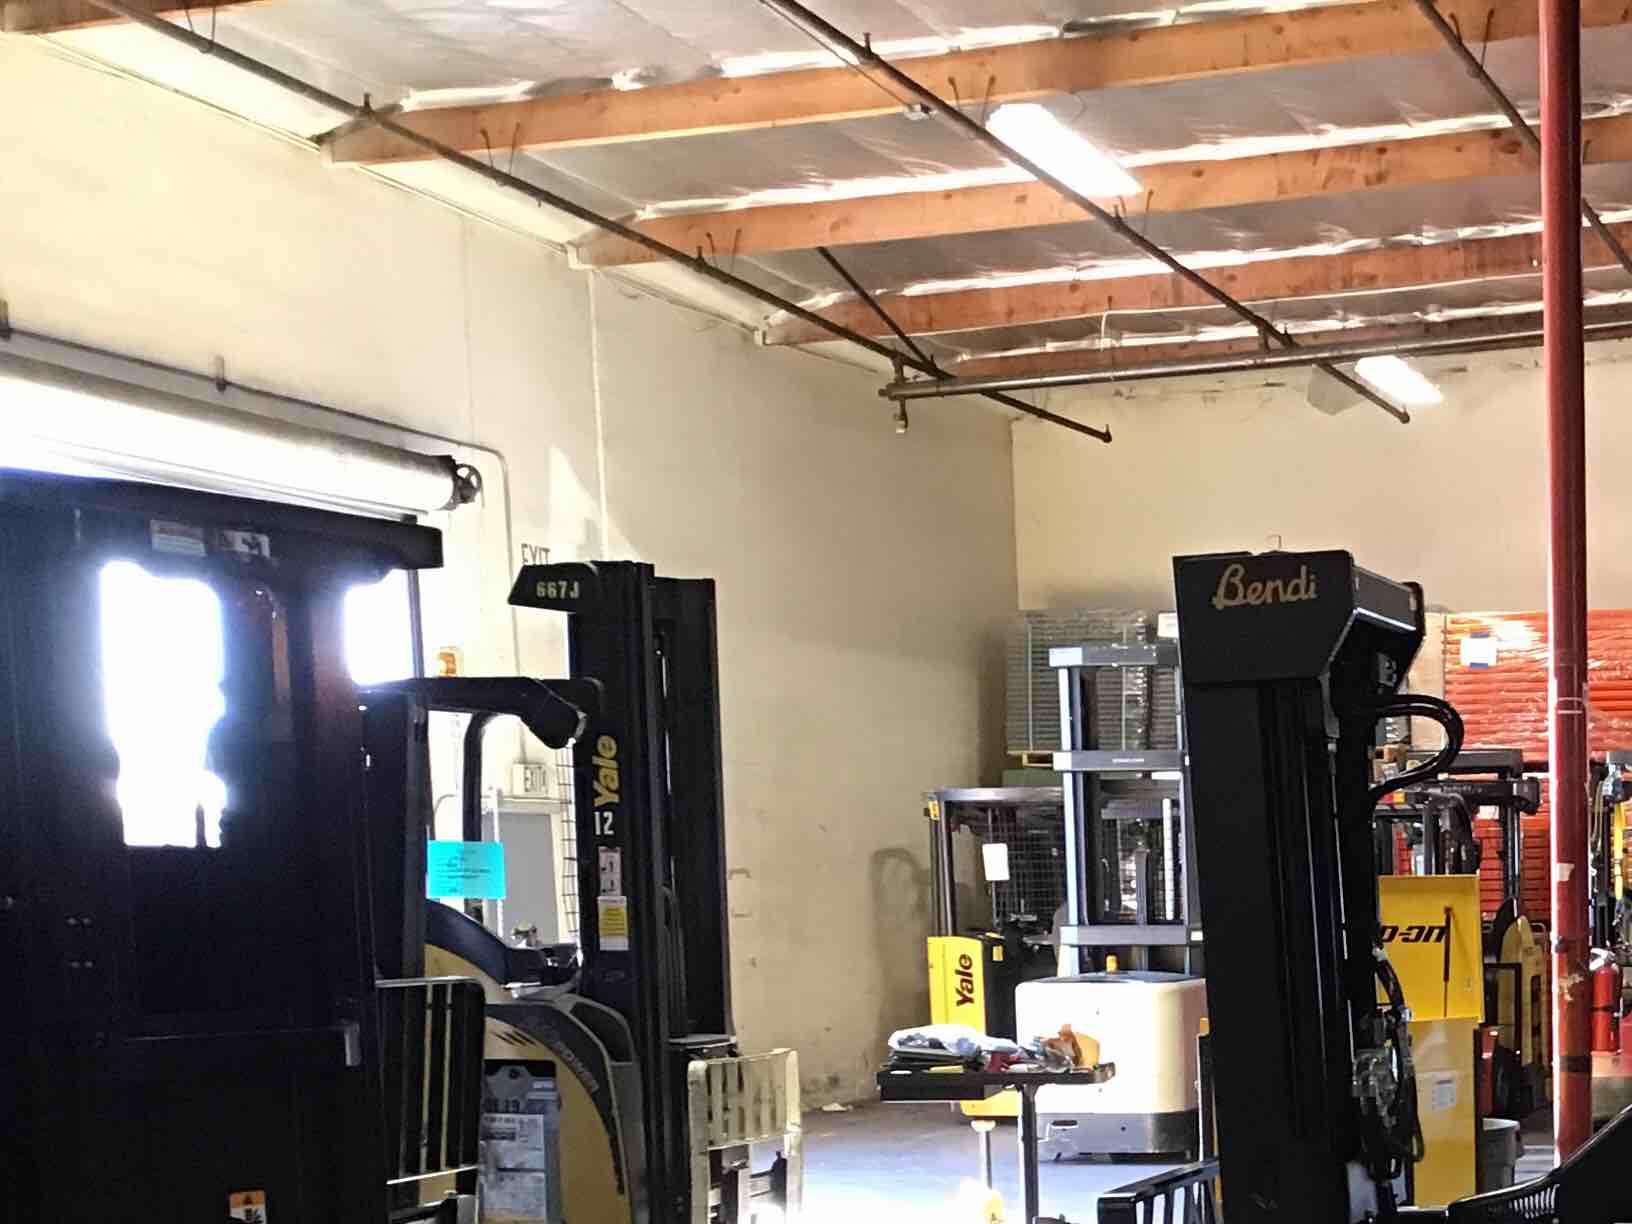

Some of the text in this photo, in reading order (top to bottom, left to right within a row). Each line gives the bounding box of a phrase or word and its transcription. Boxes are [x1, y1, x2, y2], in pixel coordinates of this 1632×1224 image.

[536, 580, 580, 598] 667J
[1211, 563, 1319, 609] Bendi
[592, 735, 619, 807] Yale
[593, 811, 615, 835] 12
[954, 953, 975, 1007] Yale
